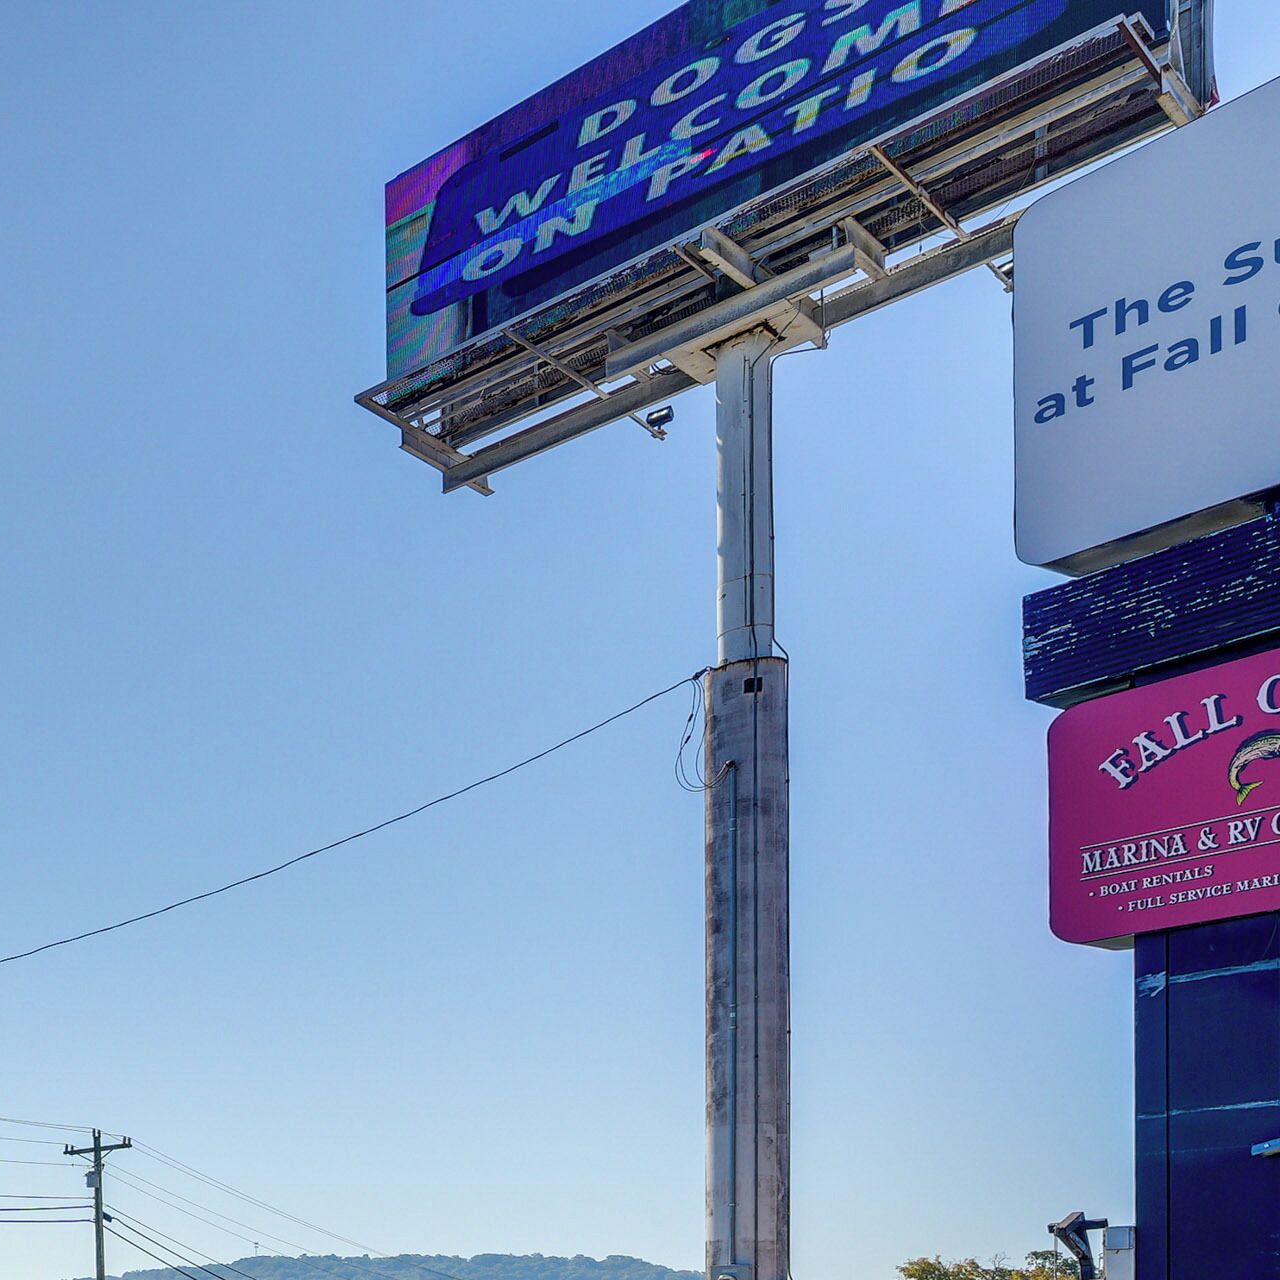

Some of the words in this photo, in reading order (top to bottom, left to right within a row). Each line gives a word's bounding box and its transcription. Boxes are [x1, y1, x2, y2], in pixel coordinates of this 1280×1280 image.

[461, 197, 600, 283] ON
[645, 26, 977, 202] PATIO
[1069, 279, 1195, 349] The
[1033, 374, 1095, 424] at
[1121, 305, 1247, 391] Fall
[1097, 692, 1240, 791] FALL
[1081, 832, 1187, 874] MARINA
[1197, 827, 1219, 851] &
[1227, 816, 1262, 846] RV
[1099, 879, 1139, 897] BOAT
[1142, 864, 1214, 890] RENTALS
[1127, 895, 1166, 912] FULL
[1169, 881, 1233, 905] SERVICE
